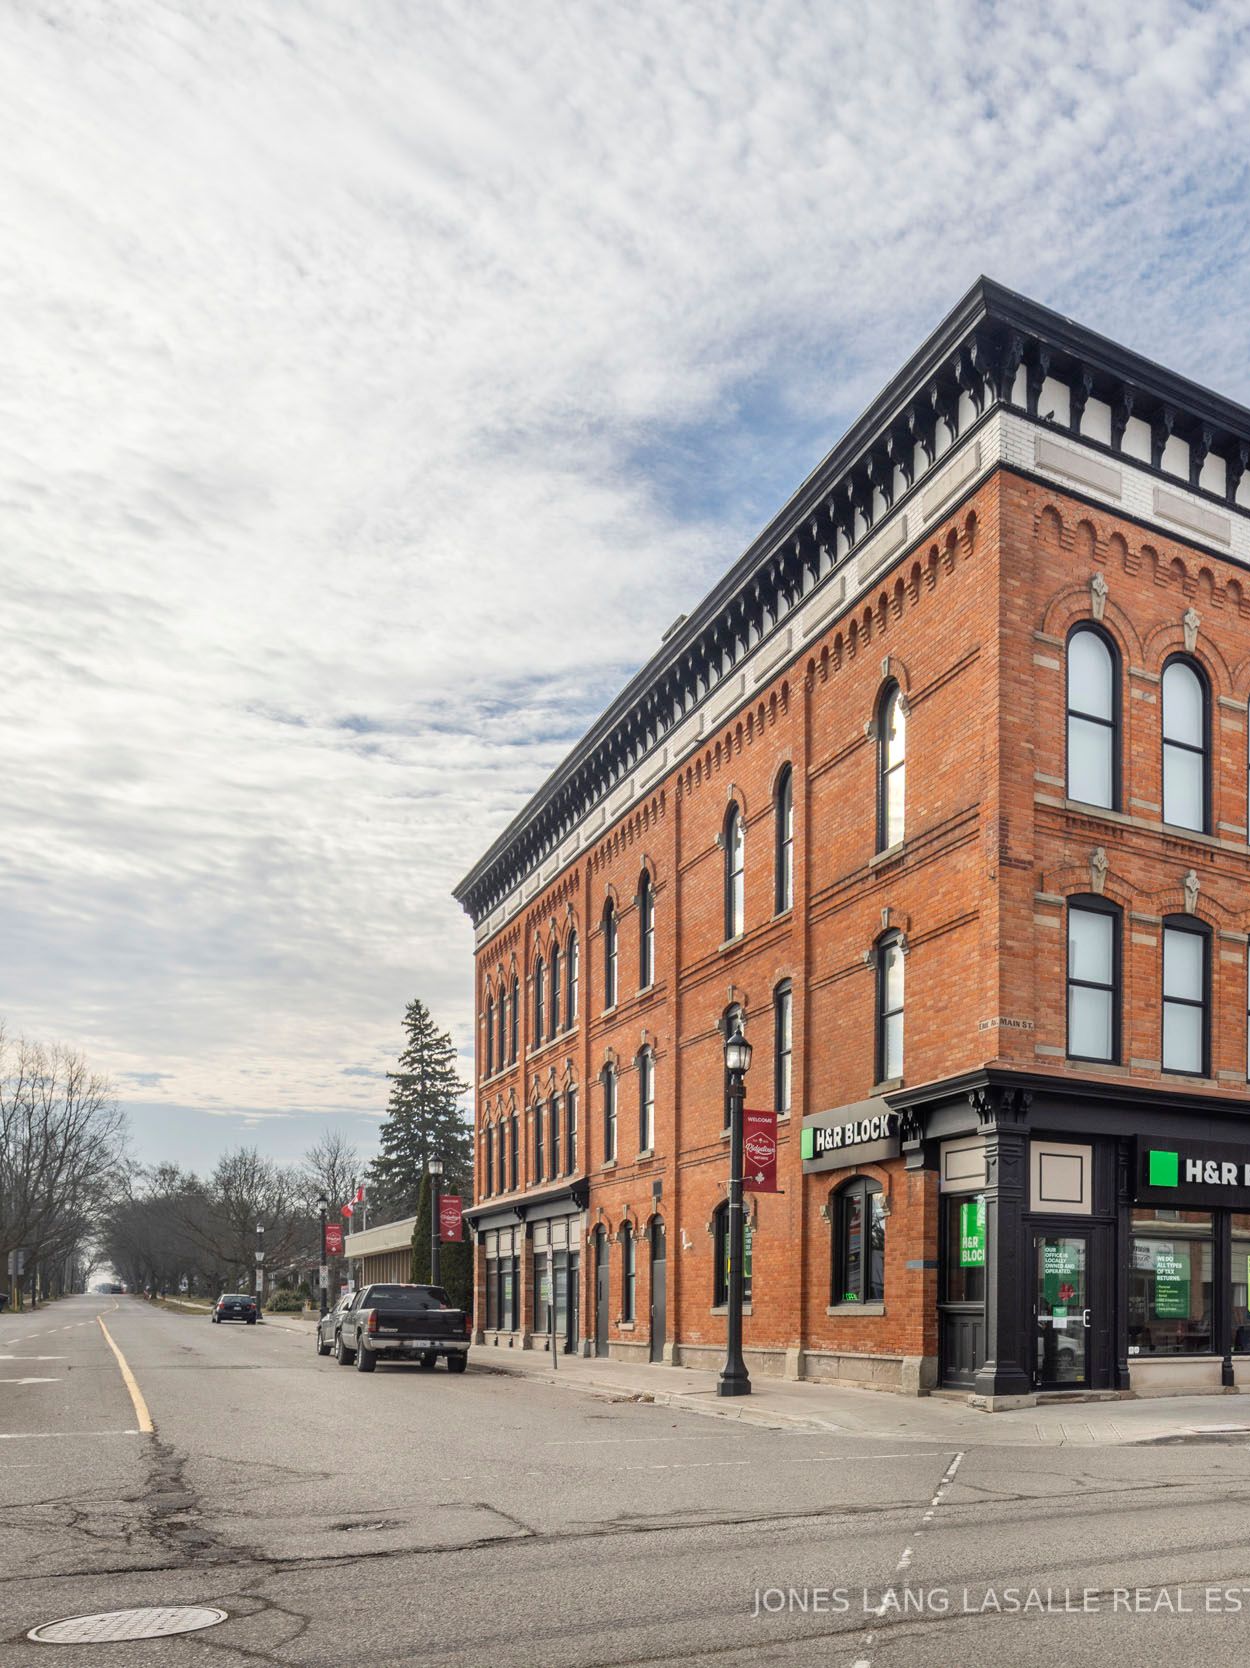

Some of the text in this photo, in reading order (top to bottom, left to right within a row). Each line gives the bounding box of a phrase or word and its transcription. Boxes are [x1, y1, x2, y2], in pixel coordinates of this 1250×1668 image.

[1000, 1017, 1020, 1028] MAIN
[816, 1113, 890, 1152] H&R BLOCK
[1186, 1158, 1238, 1186] H&R
[962, 1235, 979, 1249] H&R
